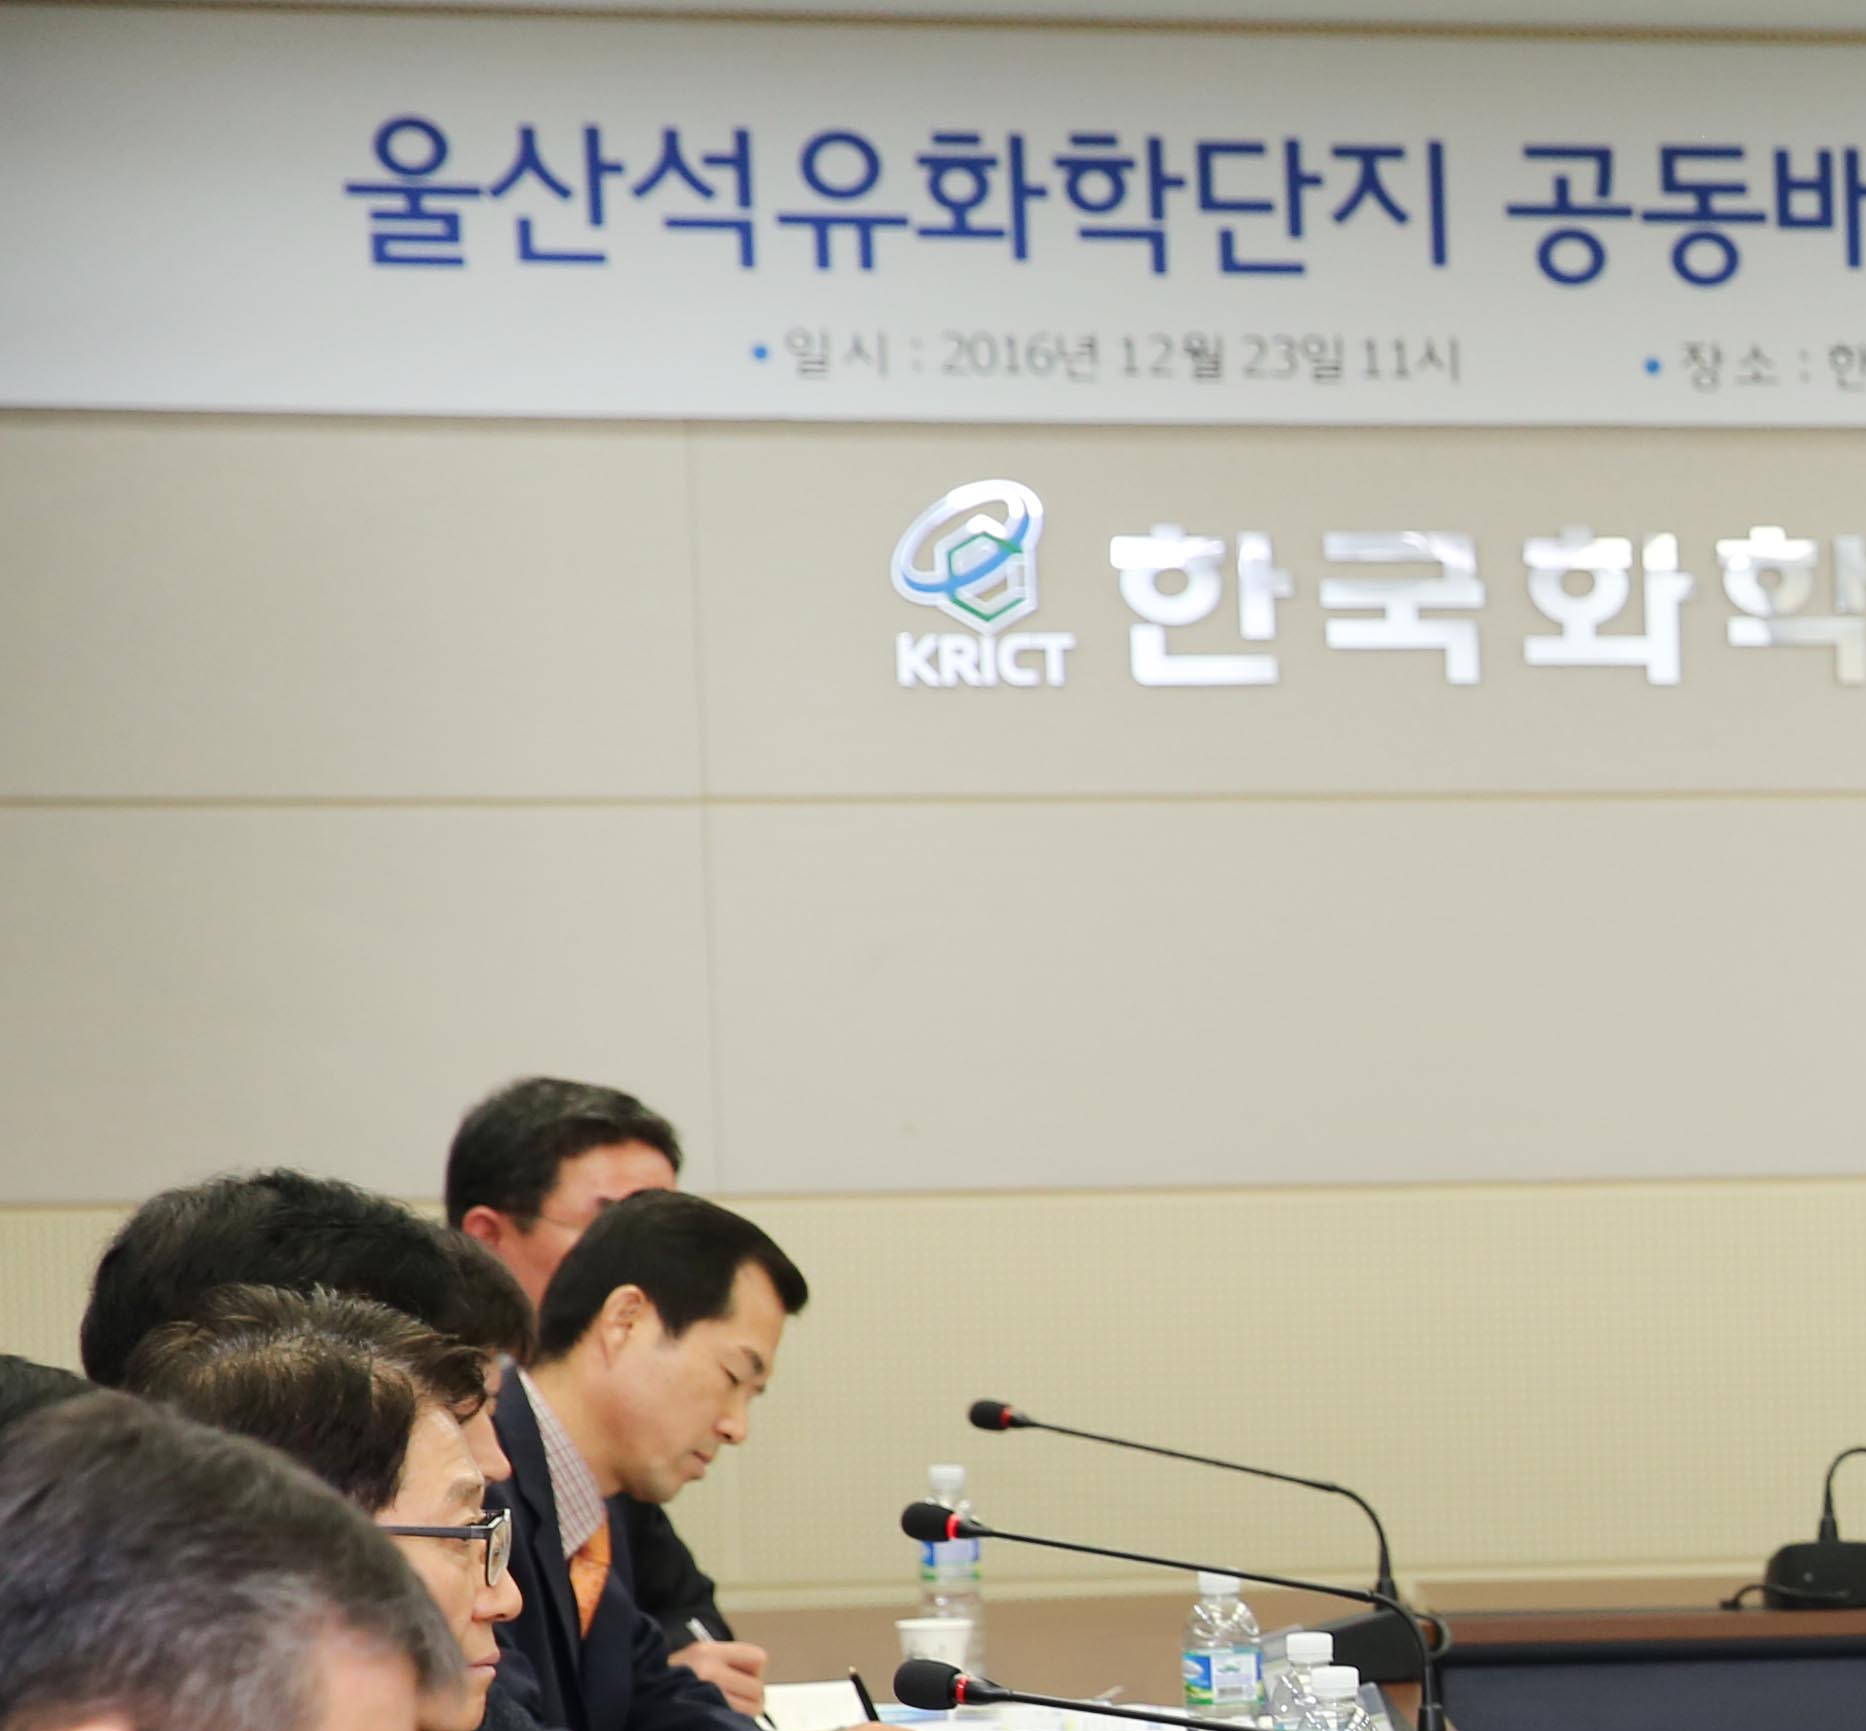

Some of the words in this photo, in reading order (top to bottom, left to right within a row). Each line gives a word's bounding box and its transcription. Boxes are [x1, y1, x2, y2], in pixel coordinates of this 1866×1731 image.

[345, 118, 1448, 276] 울산석유화학단지
[943, 333, 1100, 383] 2016년
[1122, 333, 1225, 384] 12월
[1242, 334, 1345, 385] 23일
[1364, 338, 1460, 382] 11시
[895, 630, 1077, 687] KRICT
